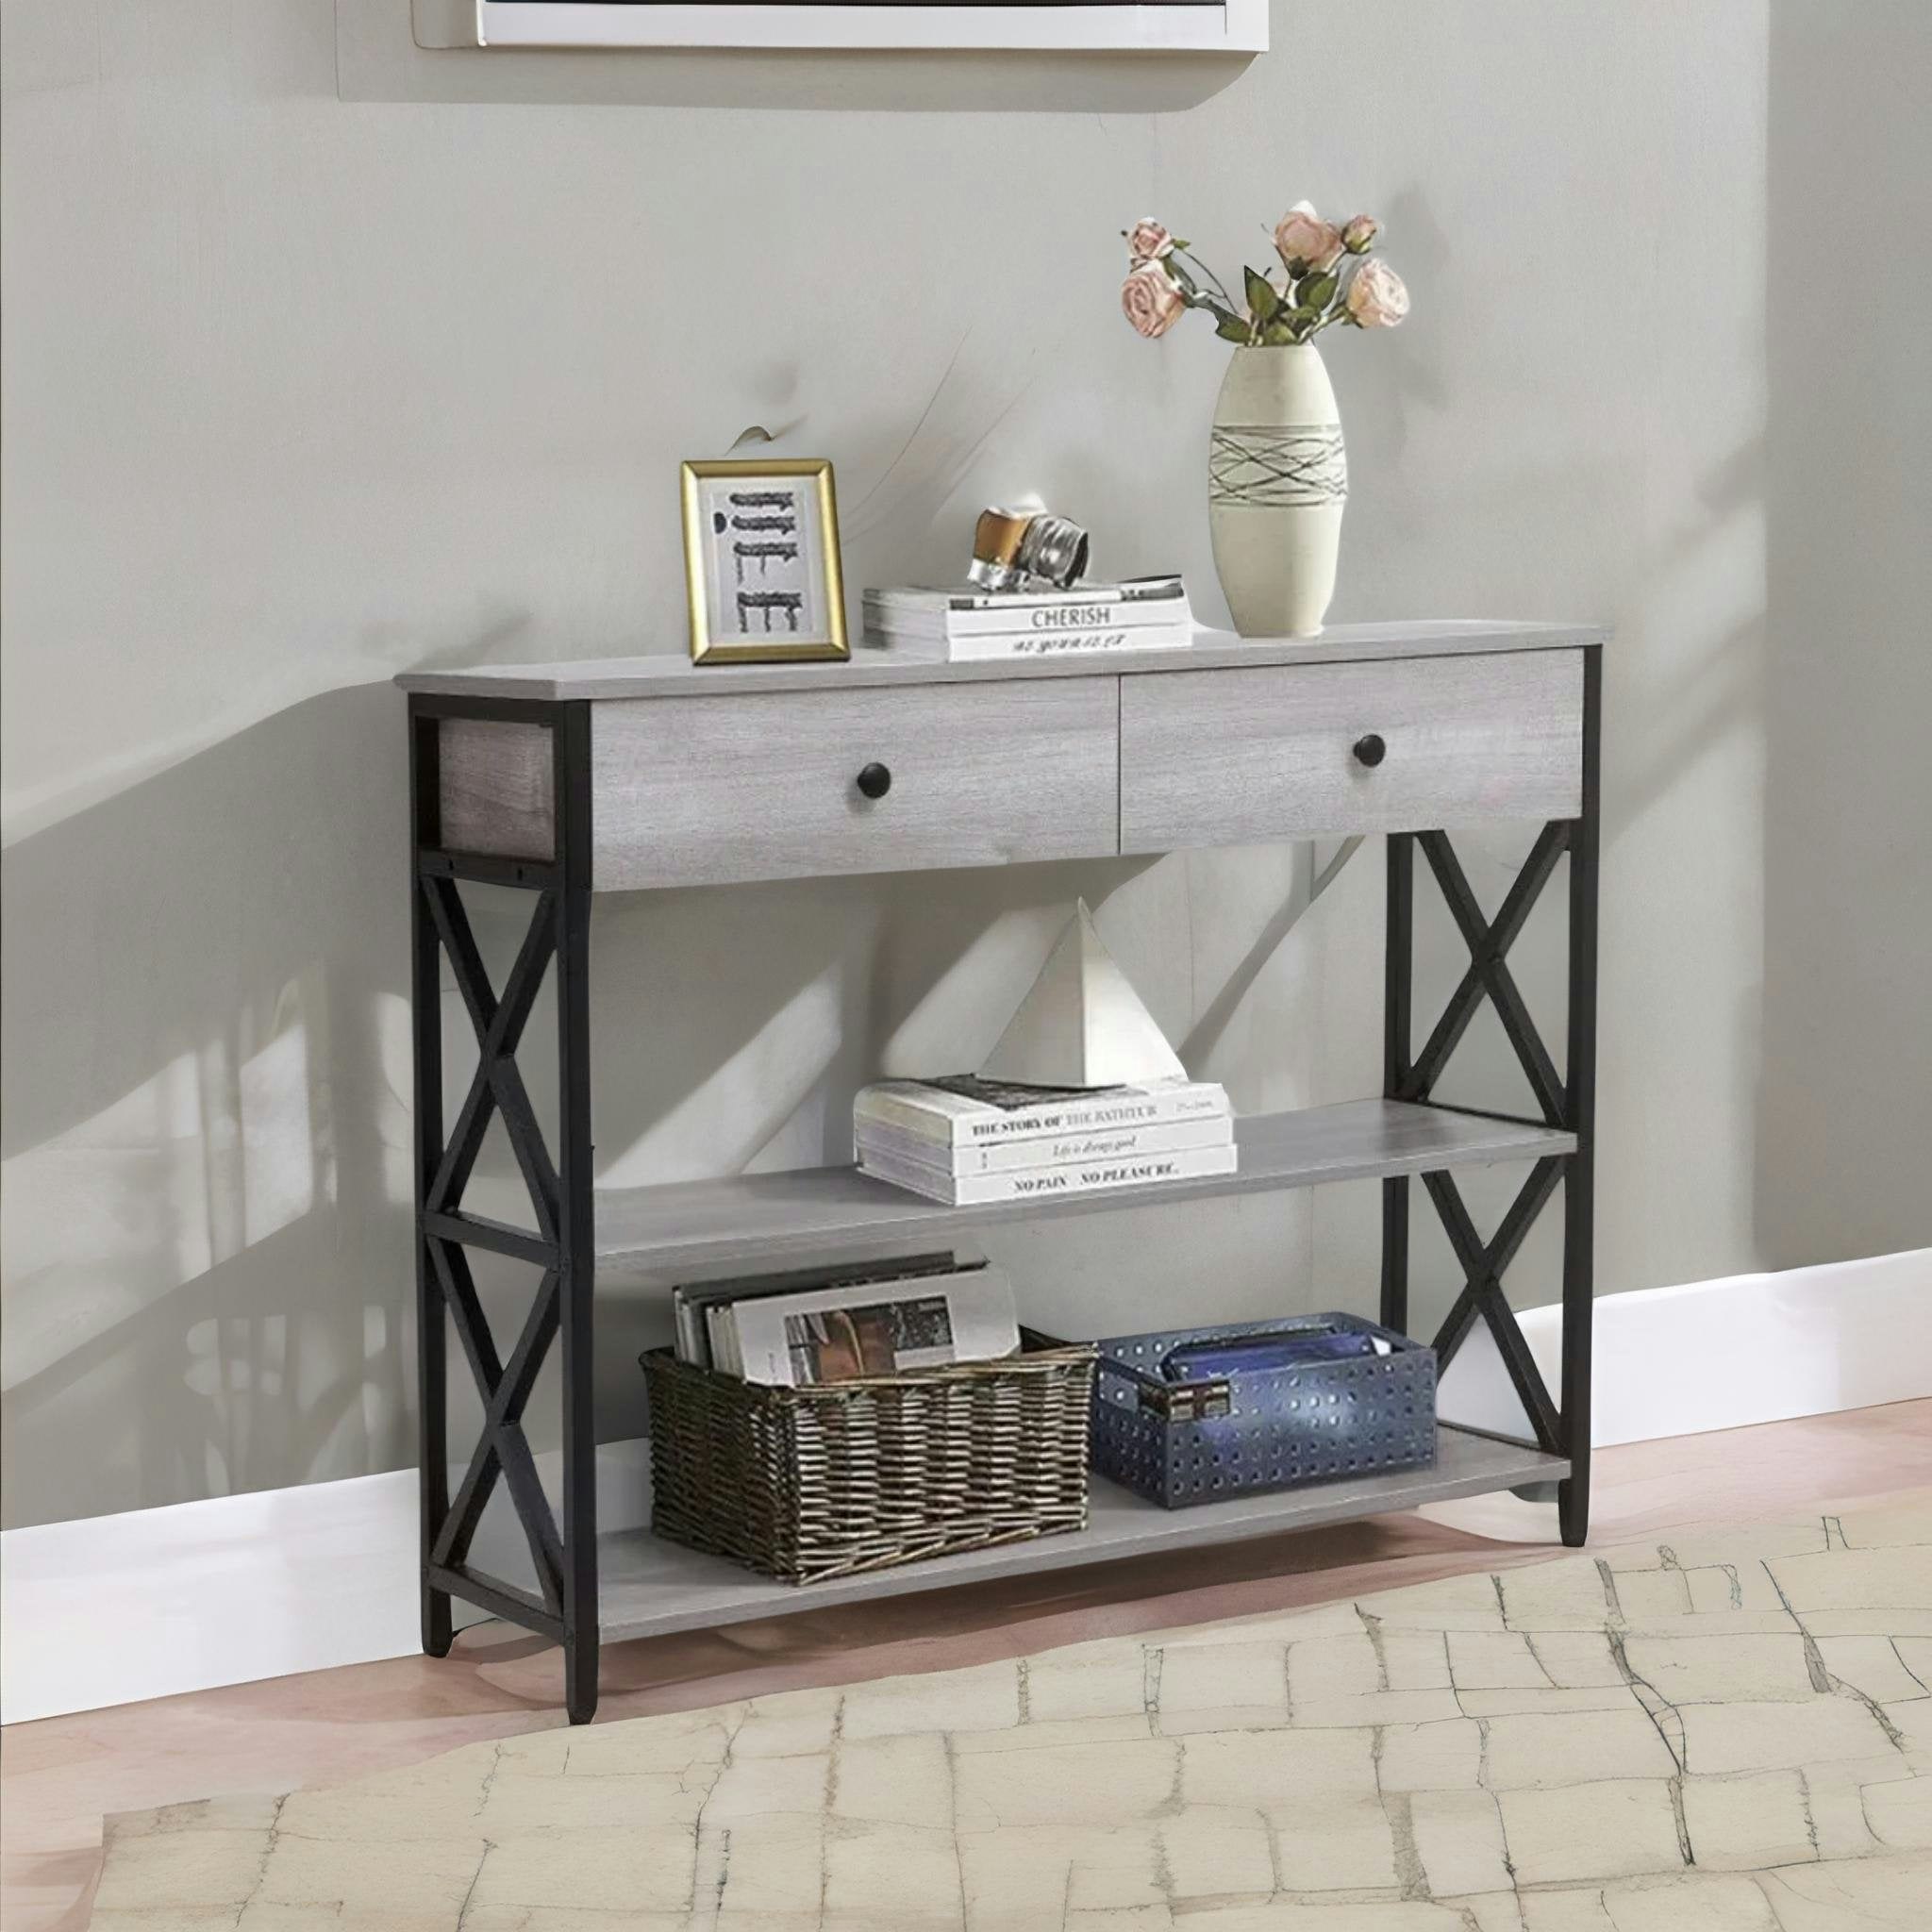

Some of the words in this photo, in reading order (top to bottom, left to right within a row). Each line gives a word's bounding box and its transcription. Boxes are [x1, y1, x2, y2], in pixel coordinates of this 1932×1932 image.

[1031, 607, 1111, 627] CHERISH
[973, 1122, 998, 1136] THE
[1001, 1117, 1041, 1132] STORY
[1043, 1114, 1063, 1127] OF
[1014, 1179, 1034, 1191] NO
[1037, 1175, 1067, 1190] PAIN
[1081, 1172, 1101, 1185] NO
